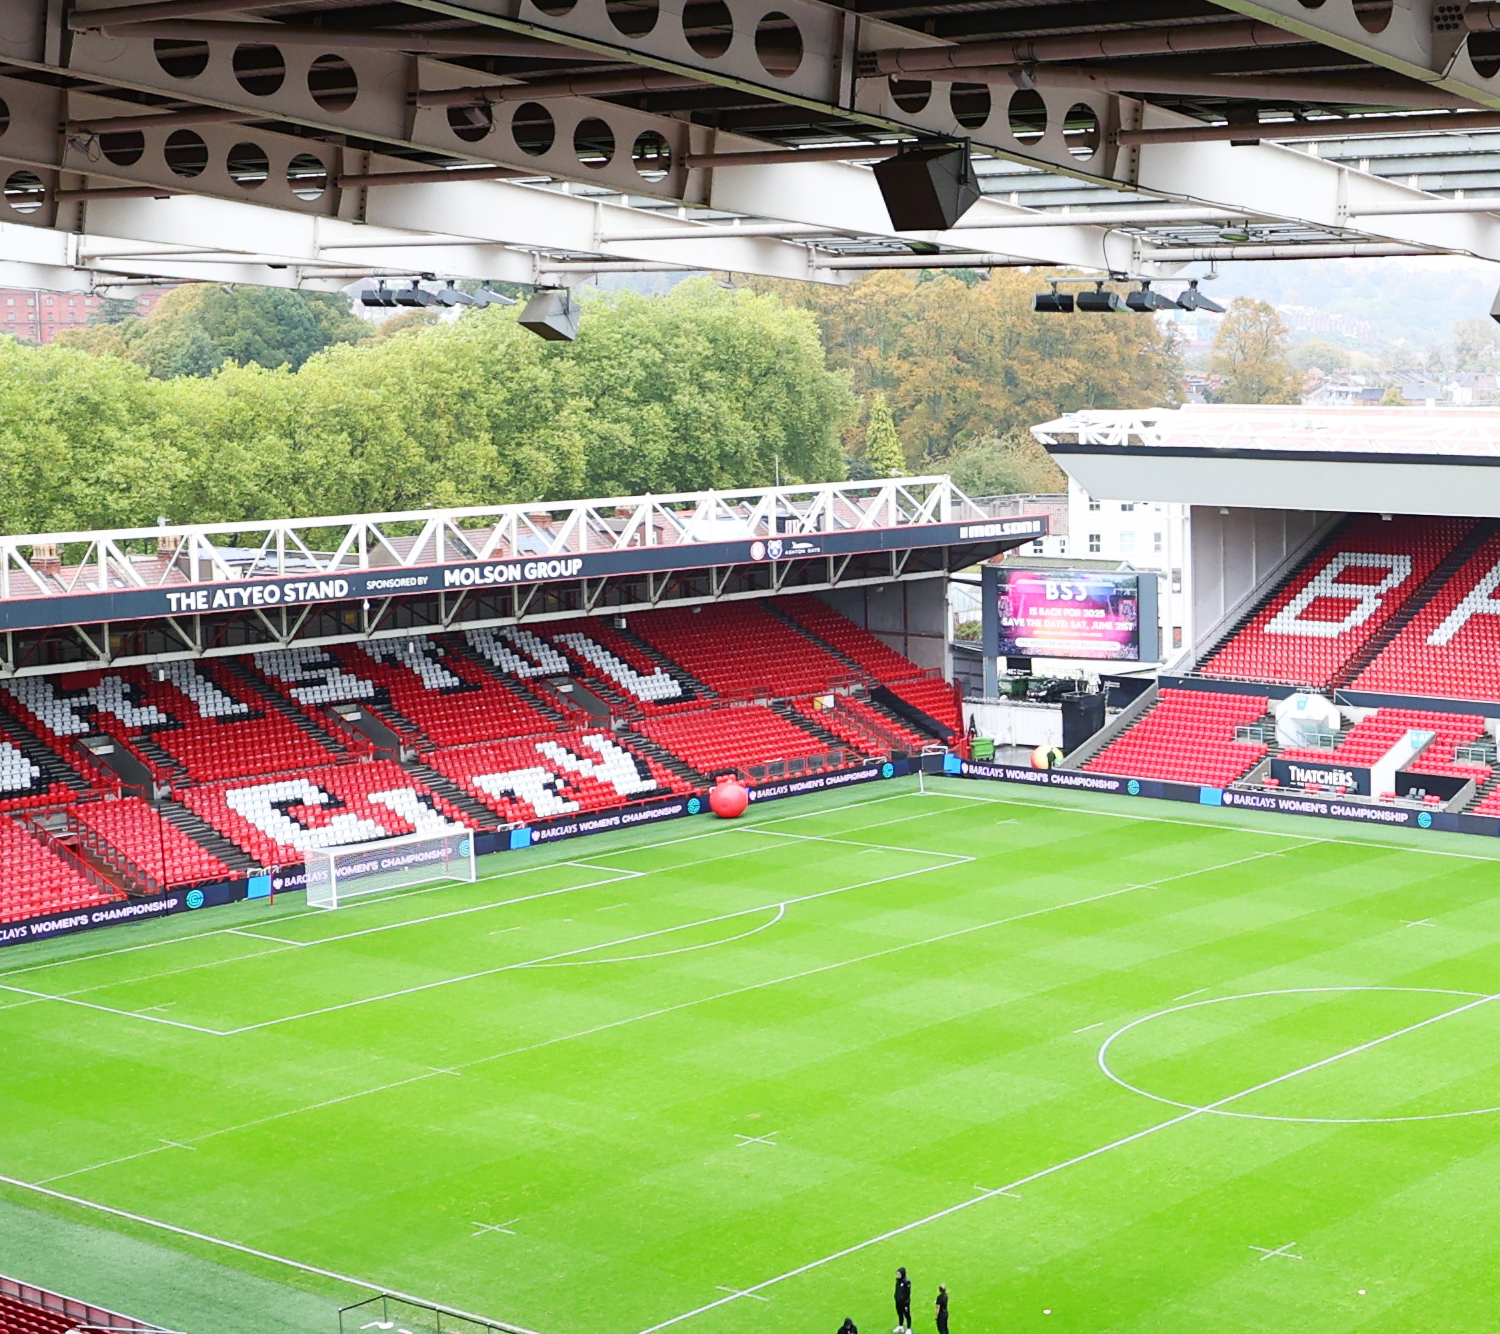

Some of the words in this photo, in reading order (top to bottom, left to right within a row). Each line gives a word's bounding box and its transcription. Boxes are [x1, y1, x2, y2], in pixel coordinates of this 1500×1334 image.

[968, 520, 1032, 538] MOLSON
[366, 578, 417, 591] SPONSORED
[417, 575, 428, 586] BY
[443, 563, 522, 588] MOLSON
[524, 558, 583, 581] GROUP
[166, 589, 208, 612] THE
[211, 584, 276, 608] ATYEO
[284, 580, 348, 602] STAND
[1045, 580, 1088, 601] BS3
[1001, 617, 1025, 627] SAVE
[1026, 618, 1042, 627] THE
[1091, 621, 1113, 631] JUNE
[1029, 608, 1038, 616] IS
[1039, 608, 1062, 617] BACK
[1063, 608, 1080, 617] FOR
[1083, 609, 1106, 618] 2025
[756, 785, 788, 799] BARCLAYS
[789, 777, 825, 792] WOMEN'S
[825, 768, 879, 786] CHAMPIONSHIP
[969, 765, 1004, 778] BARCLAYS
[1005, 769, 1049, 783] WOMEN'S
[1050, 774, 1120, 790] CHAMPIONSHIP
[1288, 765, 1353, 786] THATCHERS
[540, 825, 578, 839] BARCLAYS
[579, 816, 620, 832] WOMEN'S
[621, 804, 683, 824] CHAMPIONSHIP
[1233, 794, 1276, 809] BARCLAYS
[1278, 799, 1328, 814] WOMEN'S
[1330, 804, 1409, 823] CHAMPIONSHIP
[284, 869, 329, 887] BARCLAYS
[381, 848, 453, 868] CHAMPIONSHIP
[30, 914, 89, 935] WOMEN'S
[91, 898, 178, 923] CHAMPIONSHIP
